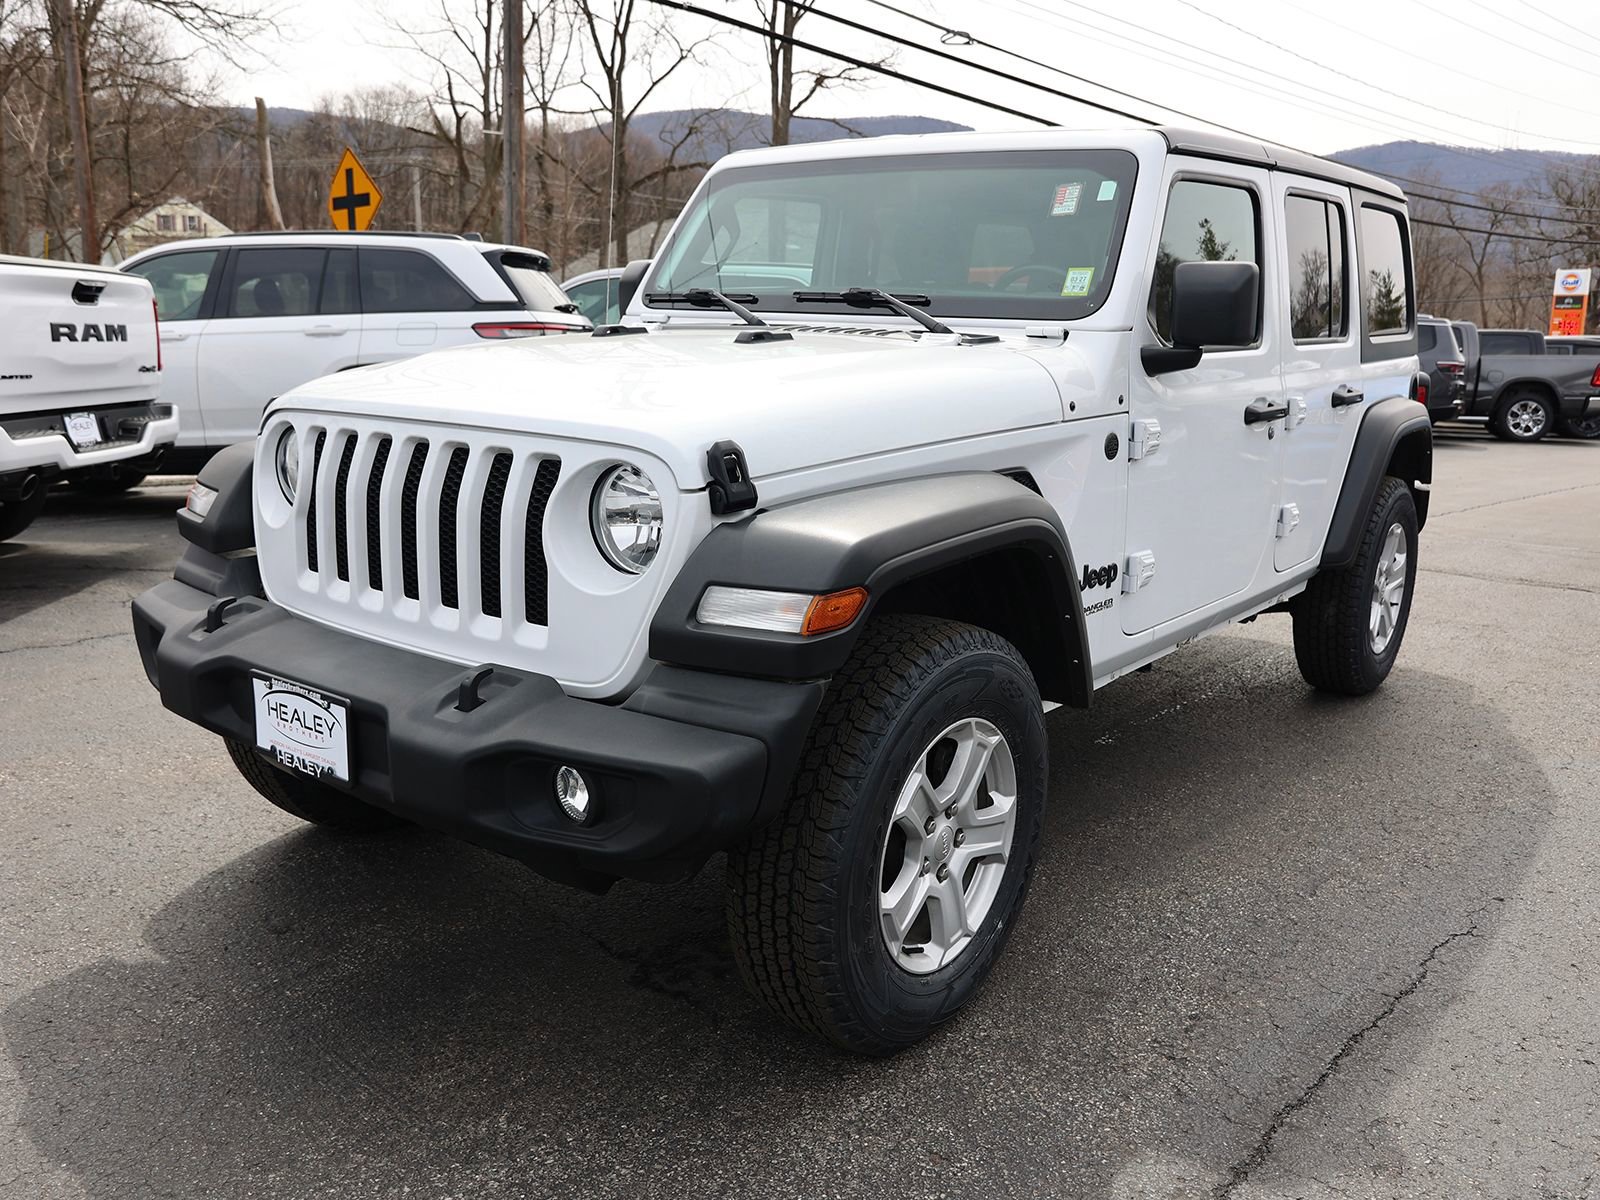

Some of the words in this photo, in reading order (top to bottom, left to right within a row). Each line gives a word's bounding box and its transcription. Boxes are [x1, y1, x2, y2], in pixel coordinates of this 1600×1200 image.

[1561, 279, 1580, 287] Gulf
[50, 322, 128, 342] RAM
[1079, 562, 1118, 592] Jeep
[267, 699, 335, 738] HEALEY
[277, 721, 325, 743] BROTHERS
[277, 749, 323, 778] HEALEY
